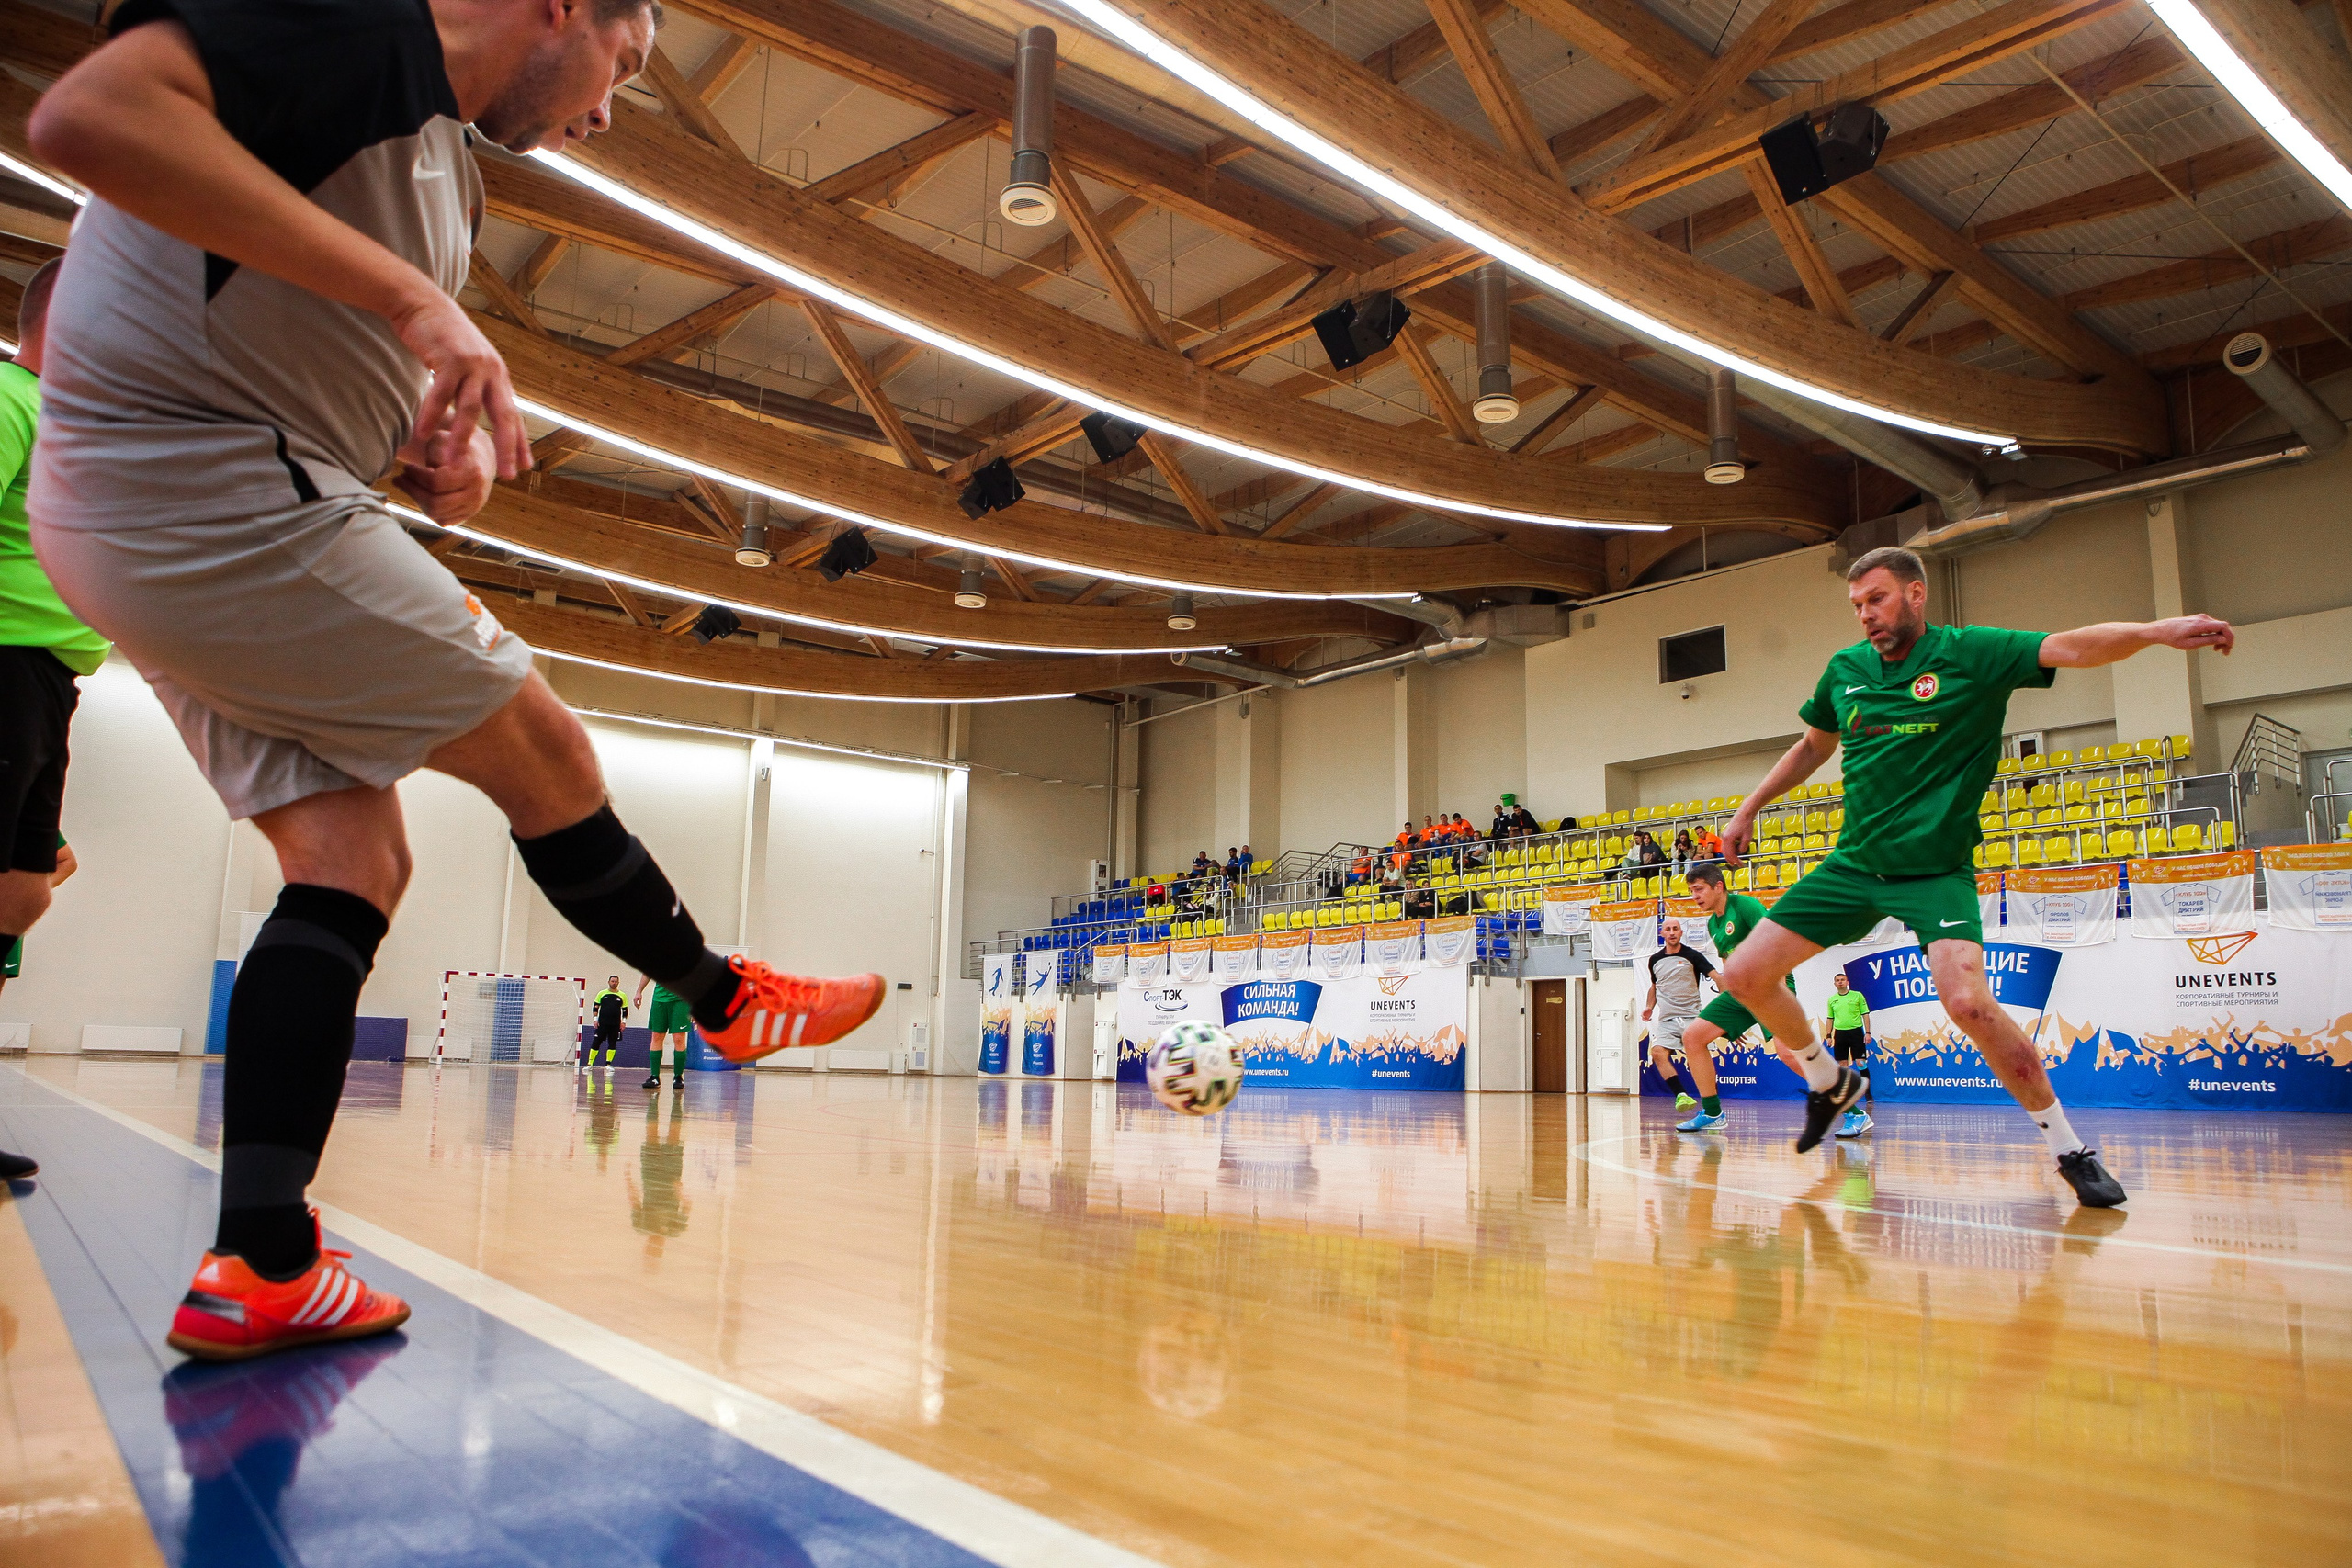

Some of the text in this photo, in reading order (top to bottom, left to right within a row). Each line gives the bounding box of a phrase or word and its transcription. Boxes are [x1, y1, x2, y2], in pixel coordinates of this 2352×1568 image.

[1864, 723, 1939, 735] TATNEFT
[1868, 959, 1883, 980] У
[2175, 972, 2277, 988] UNEVENTS
[1243, 984, 1296, 999] СИЛЬНАЯ
[2176, 992, 2234, 1000] КОРПОРАТИВНЫЕ
[1238, 1001, 1300, 1017] КОМАНДА!
[1370, 999, 1416, 1010] UNEVENTS
[1371, 1069, 1411, 1078] #unevents
[1894, 1077, 2004, 1088] www.unevents.ru
[2188, 1078, 2277, 1092] #unevents
